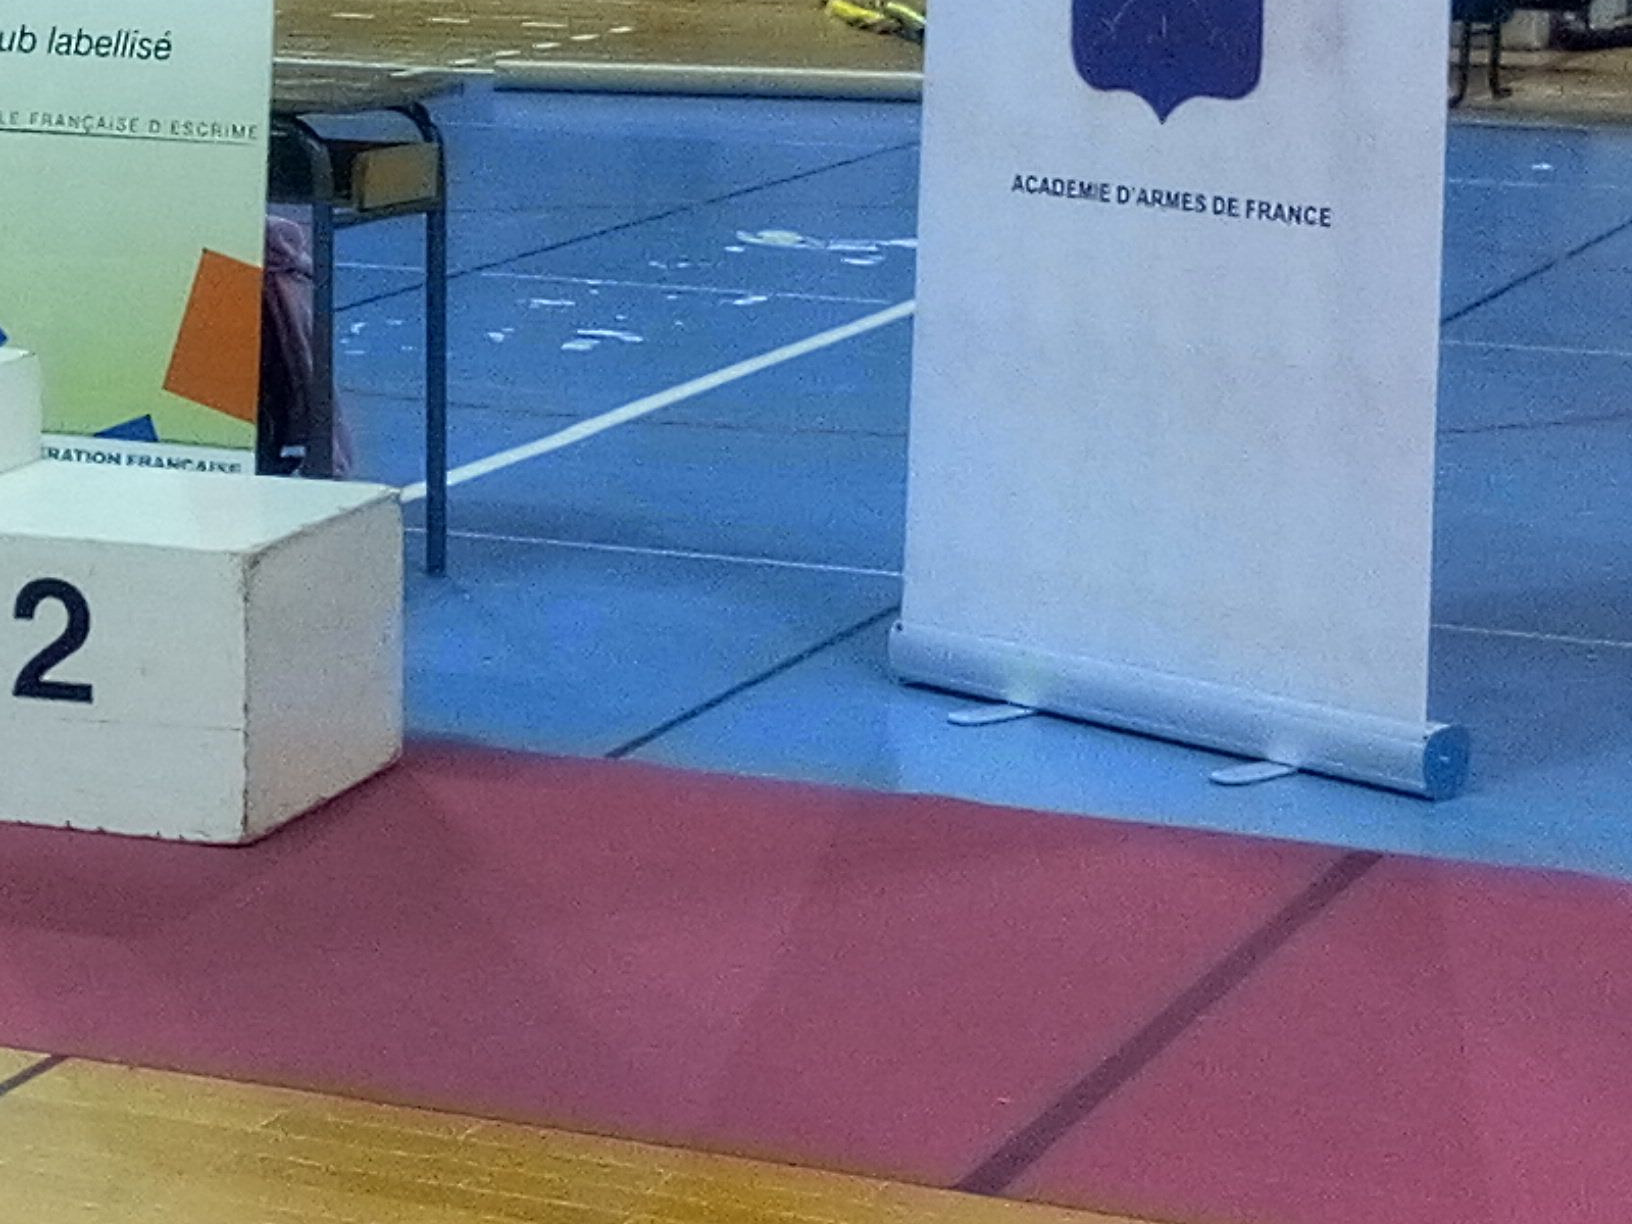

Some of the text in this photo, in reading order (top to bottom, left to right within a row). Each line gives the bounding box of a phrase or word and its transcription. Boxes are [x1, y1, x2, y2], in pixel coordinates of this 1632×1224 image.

[47, 26, 172, 60] labellisé
[1011, 174, 1332, 228] ACADEMIE D'ARMES DE FRANCE
[10, 576, 95, 704] 2
